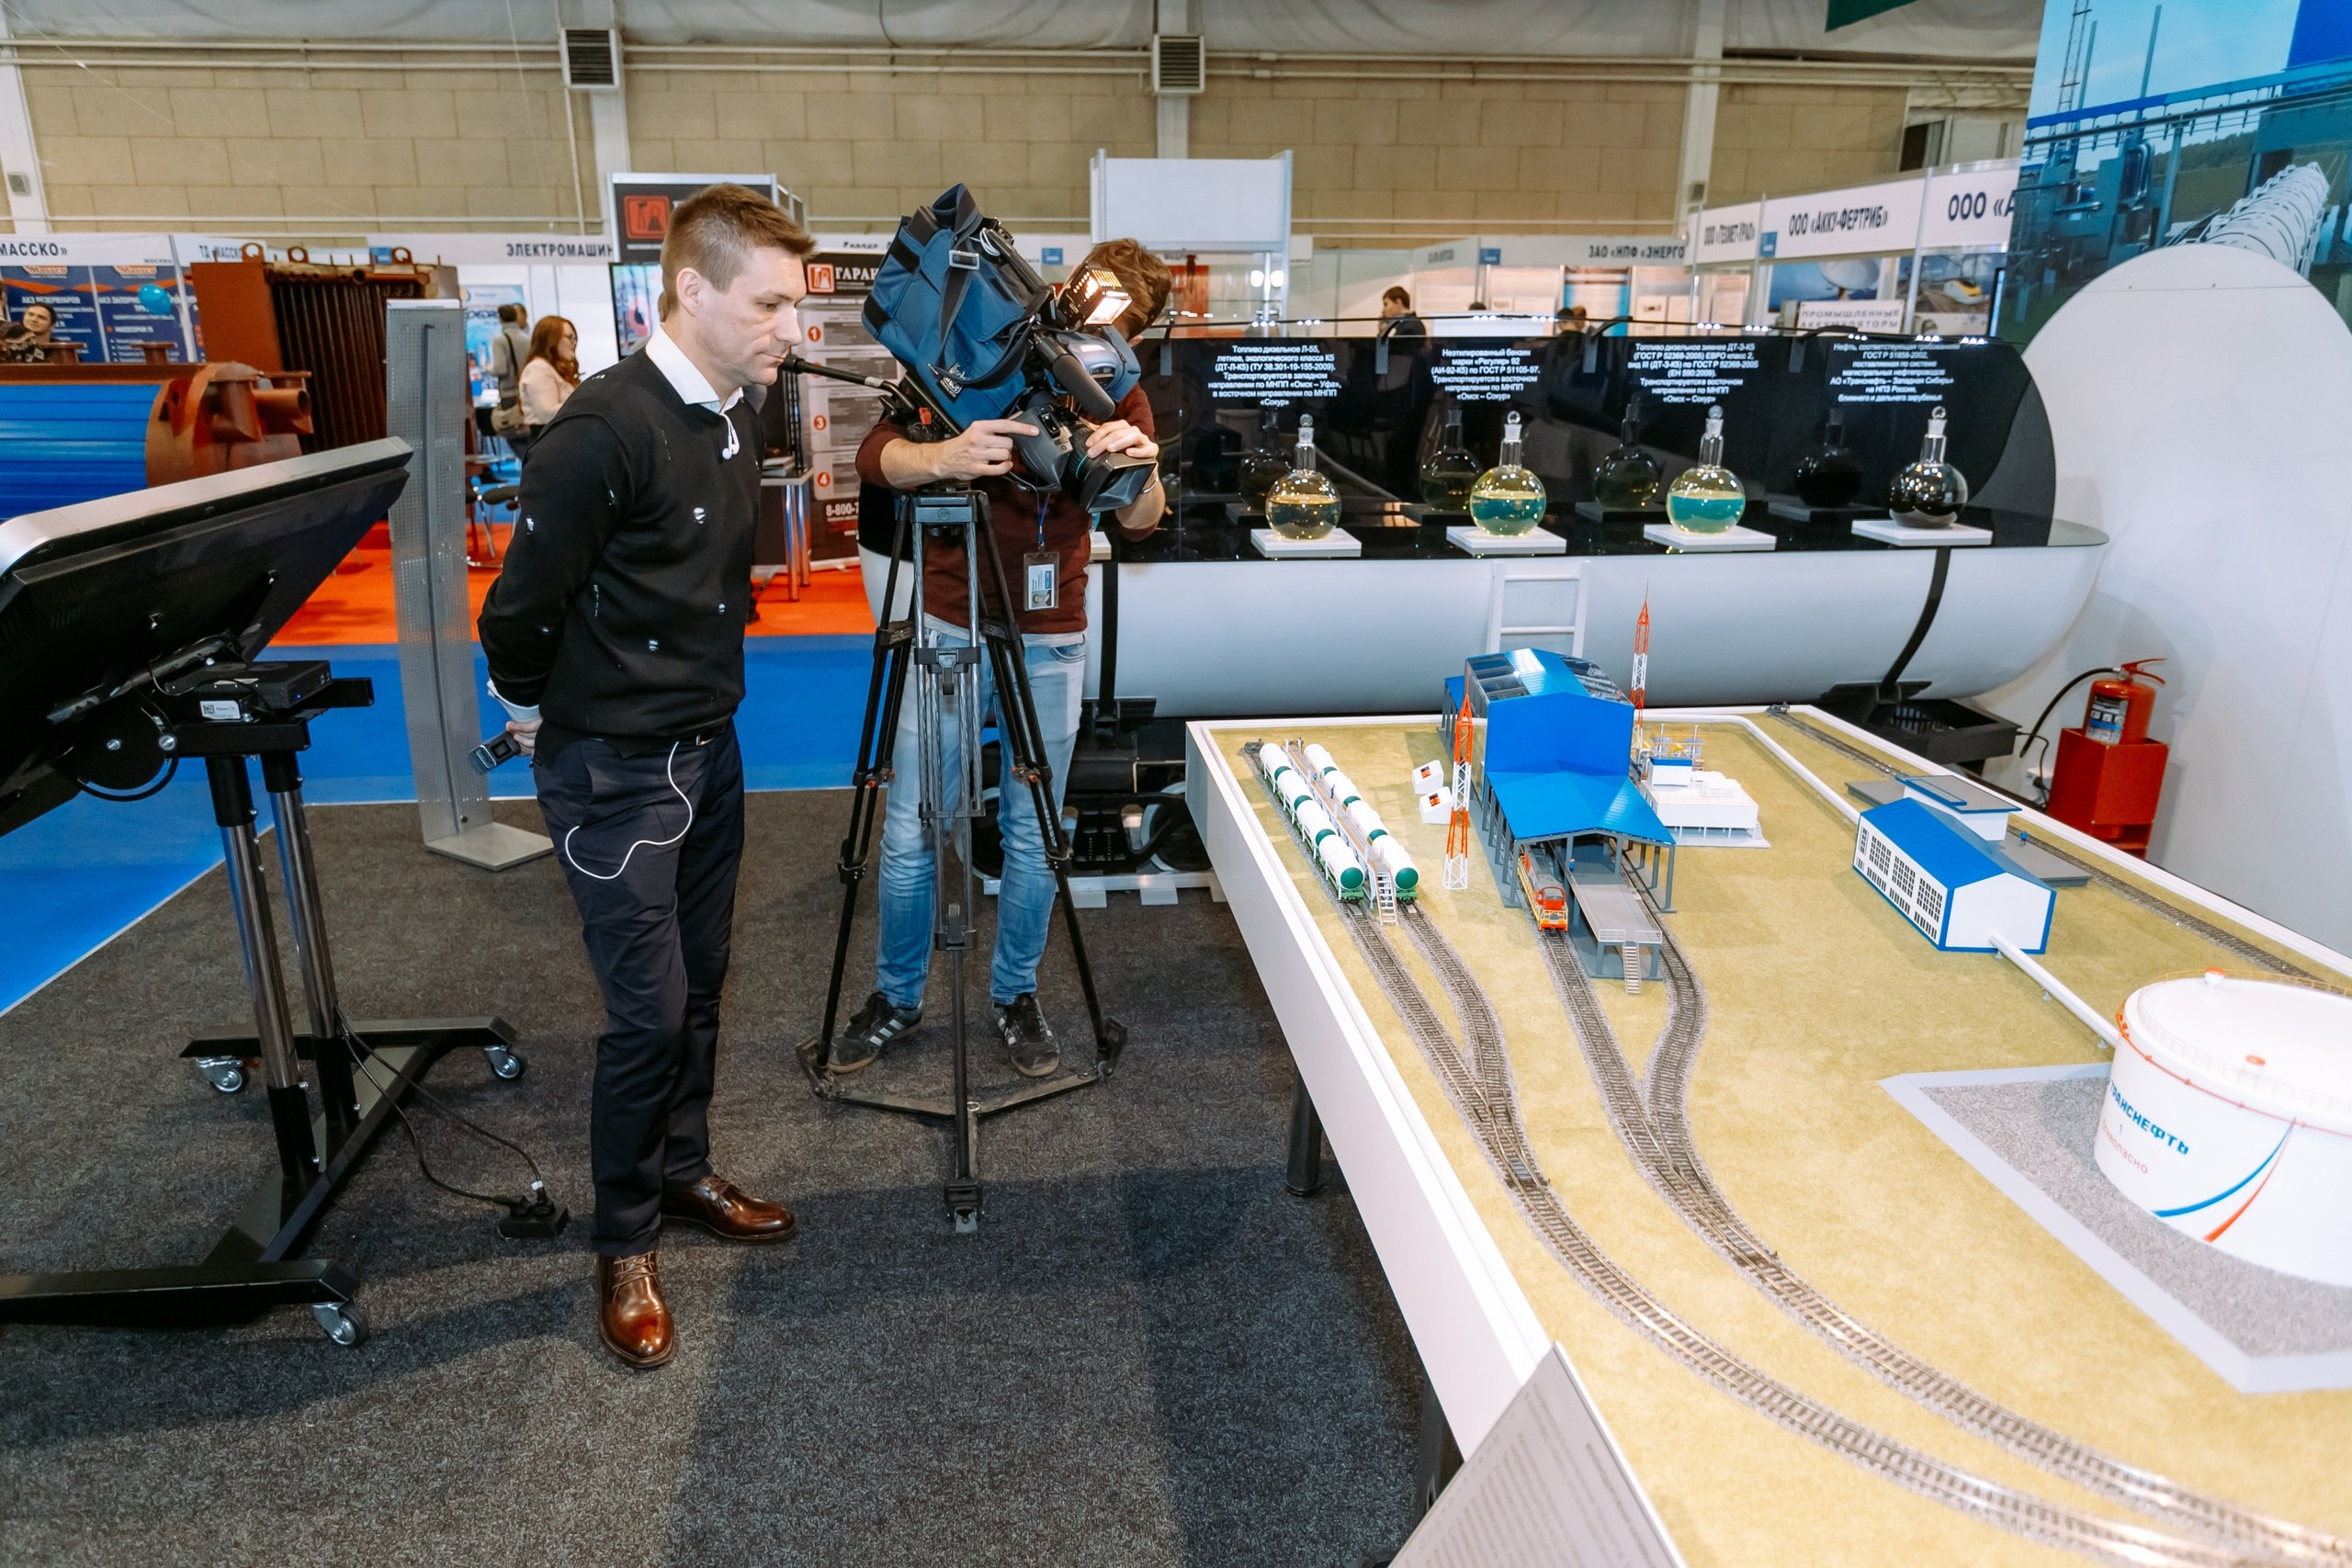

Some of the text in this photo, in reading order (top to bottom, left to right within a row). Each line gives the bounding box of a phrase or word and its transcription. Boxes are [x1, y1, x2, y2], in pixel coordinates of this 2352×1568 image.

[1948, 191, 1986, 221] ООО
[1789, 212, 1809, 236] ООО
[1589, 245, 1609, 258] ЗАО
[1802, 309, 1900, 318] ПРОМЫШЛЕННЫЕ
[1233, 345, 1262, 354] Топливо
[1263, 345, 1300, 354] дизельное
[1635, 343, 1664, 351] Топливо
[1665, 343, 1701, 351] дизельное
[1442, 349, 1531, 357] Неэтилированный бензин
[1634, 352, 1656, 360] (ГОСТ
[1657, 352, 1663, 360] Р
[1705, 352, 1725, 360] ЕВРО
[1863, 351, 1882, 359] ГОСТ
[1883, 351, 1888, 359] Р
[1683, 360, 1691, 369] по
[1692, 360, 1713, 369] ГОСТ
[1713, 360, 1718, 369] Р
[1469, 367, 1478, 375] по
[1479, 367, 1499, 375] ГОСТ
[1499, 367, 1506, 375] Р
[1433, 376, 1496, 384] Транспортируется
[1501, 376, 1538, 384] восточном
[1640, 378, 1702, 387] Транспортируется
[1707, 378, 1743, 387] восточном
[1208, 381, 1254, 389] направлении
[1256, 381, 1264, 389] по
[1266, 381, 1289, 389] МНПП
[1290, 381, 1313, 389] «Омск
[1213, 389, 1337, 398] в восточном направлении по МНПП
[1457, 392, 1479, 400] «Омск
[2110, 1079, 2189, 1155] ТРАНСНЕФТЬ
